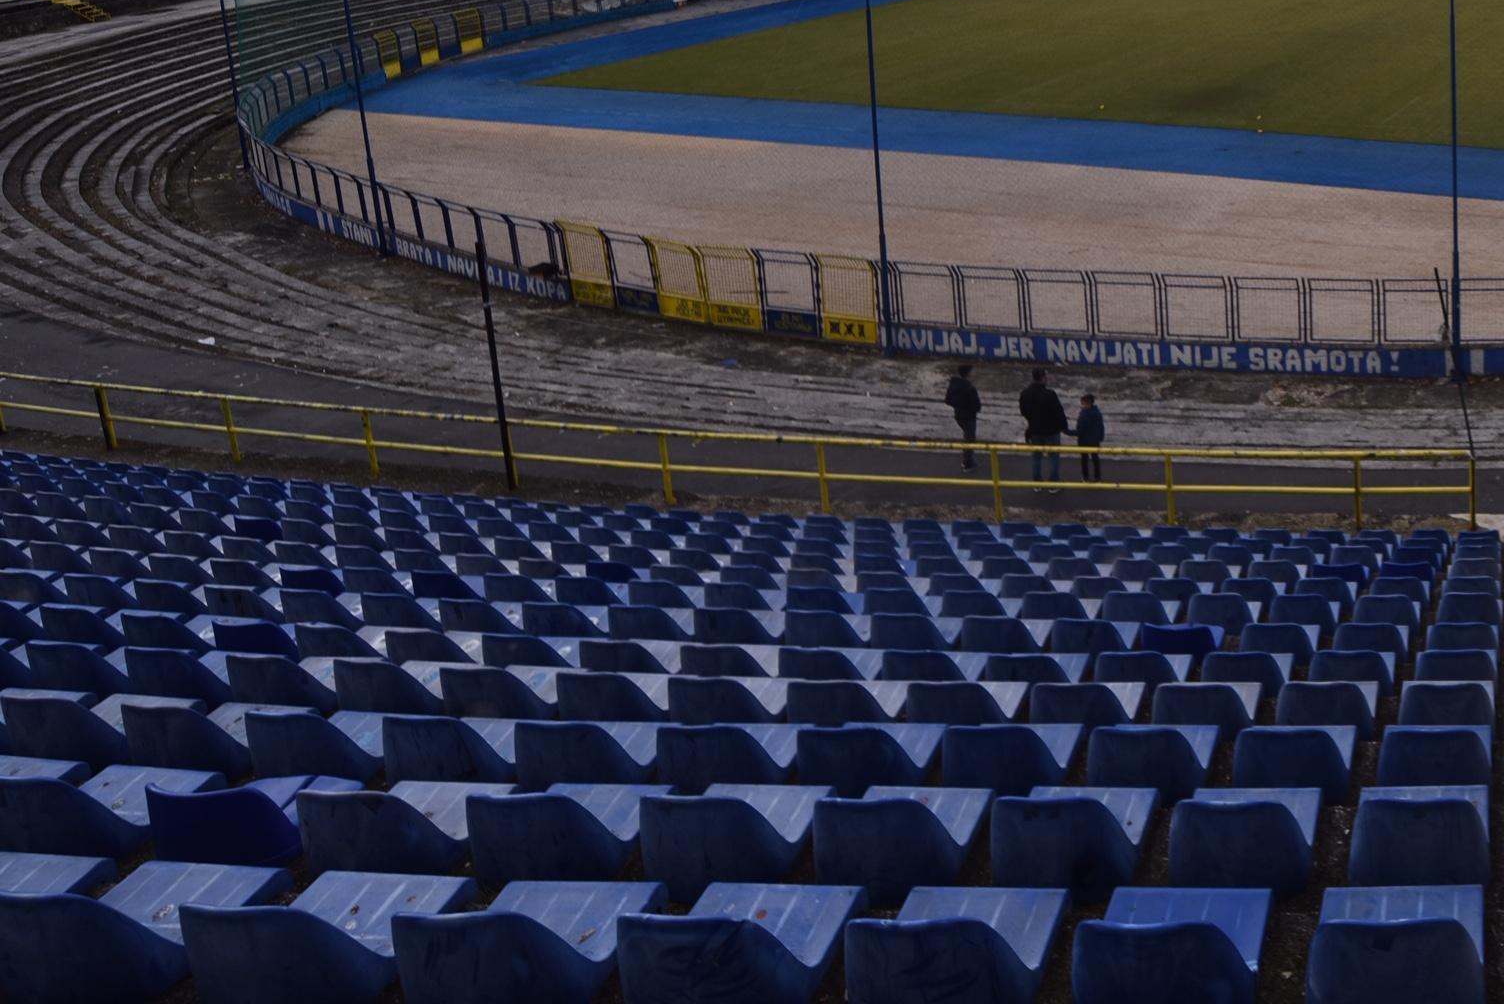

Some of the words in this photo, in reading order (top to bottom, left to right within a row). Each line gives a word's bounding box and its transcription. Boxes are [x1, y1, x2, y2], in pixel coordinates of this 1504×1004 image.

[341, 218, 374, 247] STANI
[396, 237, 432, 265] BRATA
[447, 254, 503, 287] NAVIAJ
[508, 270, 521, 292] IZ
[526, 276, 566, 301] KOPA
[993, 335, 1035, 359] JER
[1048, 337, 1160, 366] NAVIJATI
[1170, 344, 1237, 369] NIJE
